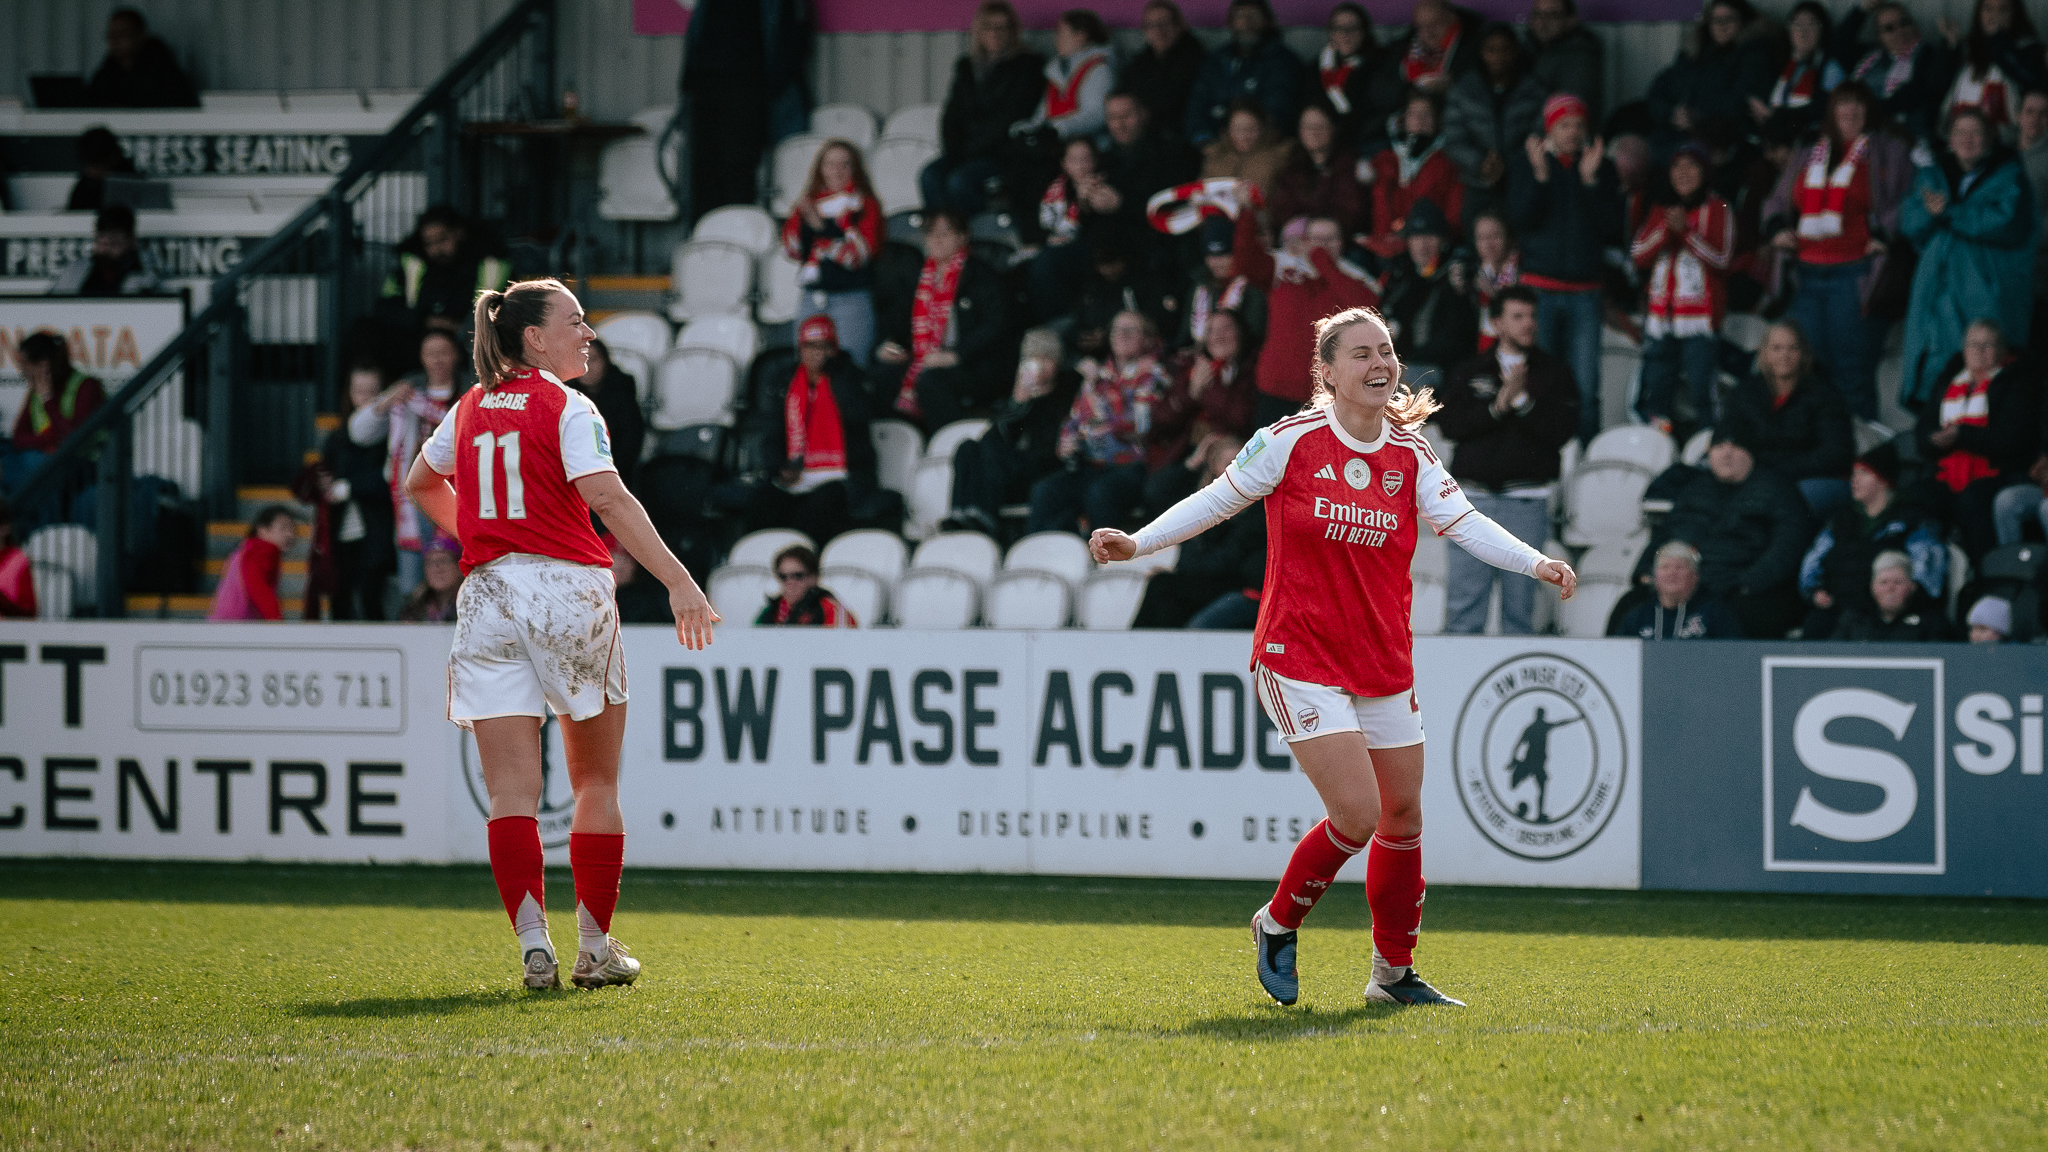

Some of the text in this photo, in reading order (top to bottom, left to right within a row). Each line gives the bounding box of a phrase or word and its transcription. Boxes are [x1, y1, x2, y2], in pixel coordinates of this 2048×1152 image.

[215, 137, 350, 174] SEATING
[472, 430, 527, 520] 11
[1313, 496, 1399, 531] Emirates
[1324, 522, 1388, 548] FLY BETTER
[150, 669, 393, 709] 01923 856 711
[661, 666, 780, 764] BW
[812, 667, 1000, 767] PASE
[1953, 691, 2045, 776] Si
[1789, 687, 1919, 843] S
[710, 806, 871, 836] ATTITUDE
[957, 809, 1153, 841] DISCIPLINE
[1243, 815, 1318, 843] DES
